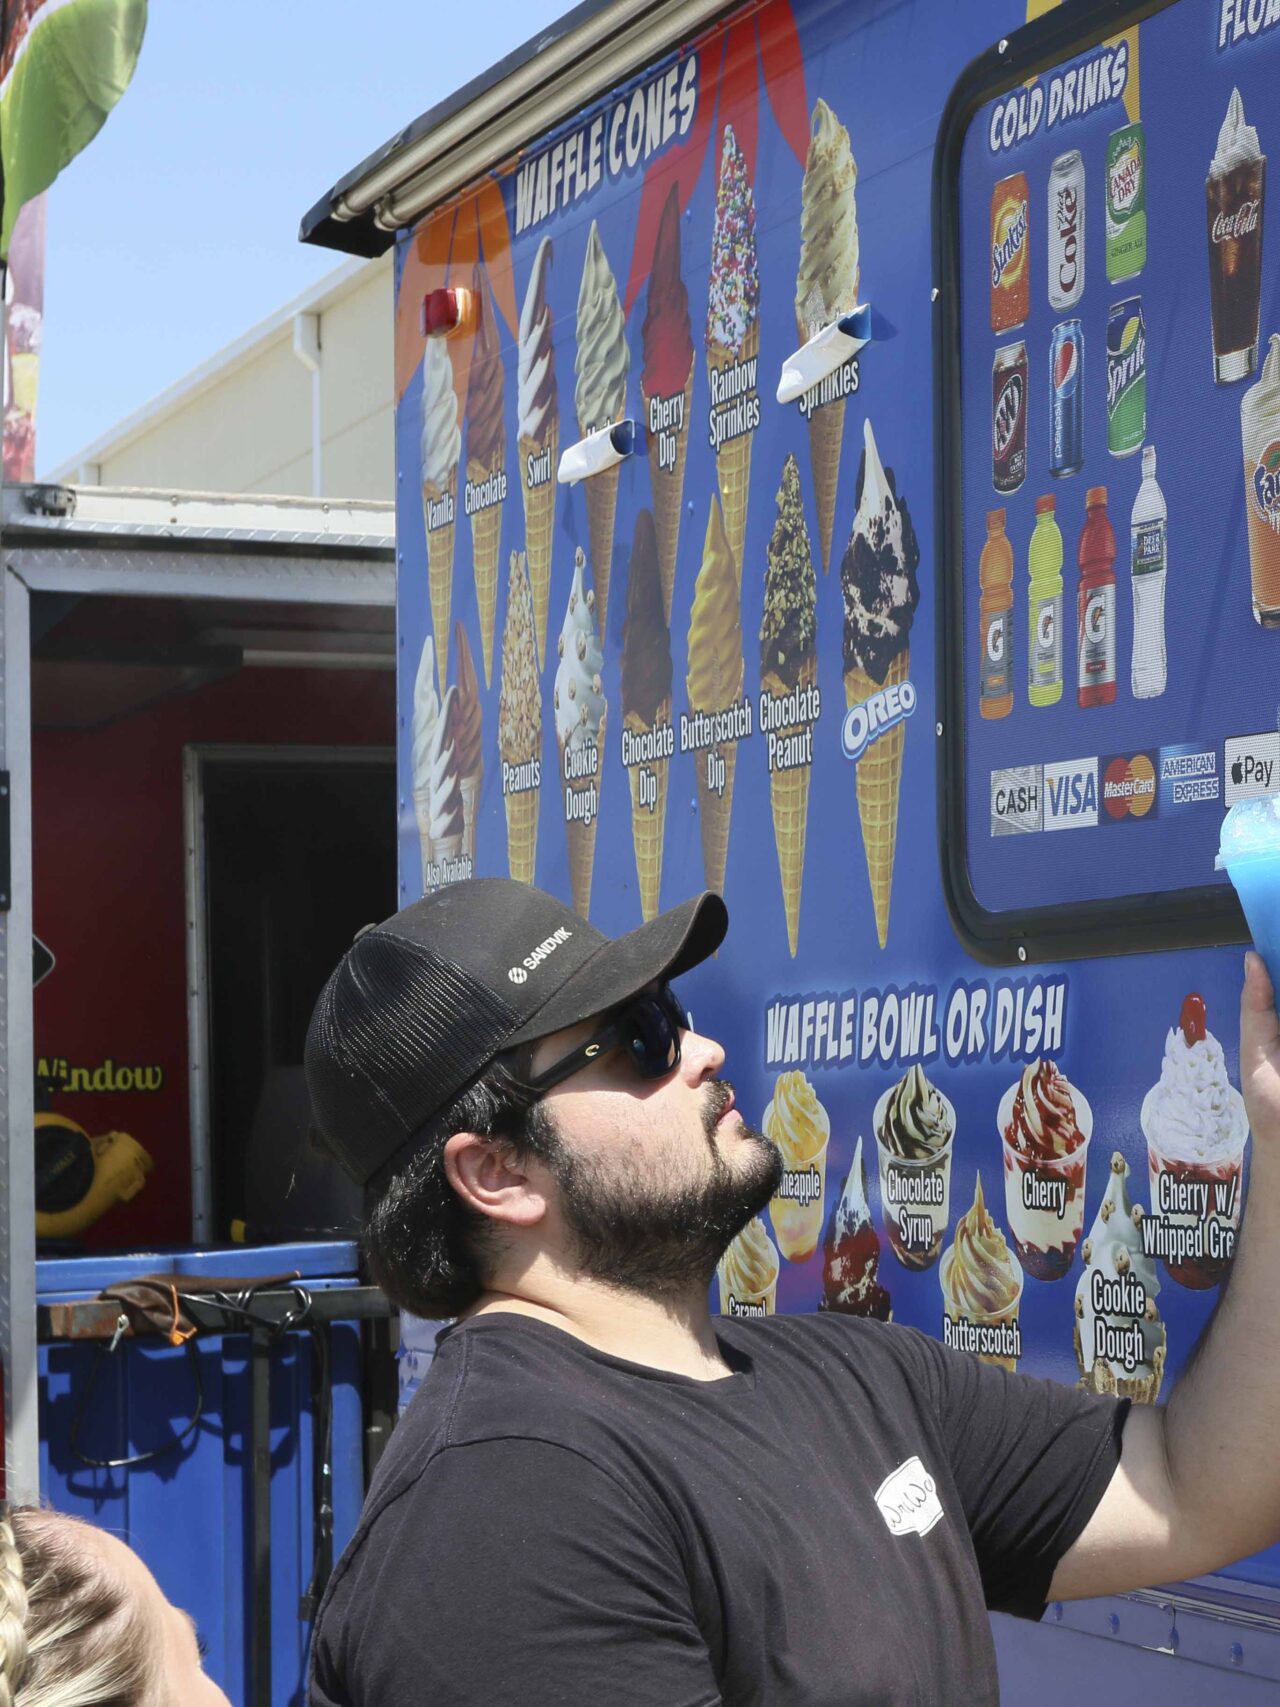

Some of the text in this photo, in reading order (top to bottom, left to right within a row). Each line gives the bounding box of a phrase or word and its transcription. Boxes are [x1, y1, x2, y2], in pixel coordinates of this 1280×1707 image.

[990, 46, 1128, 151] COLD DRINKS
[515, 56, 697, 235] WAFFLE CONES
[1110, 158, 1142, 198] CANADA
[1118, 181, 1137, 202] DRY
[991, 200, 1027, 288] Sunkist
[1059, 187, 1077, 292] Coke
[711, 359, 757, 406] Rainbow
[1107, 330, 1145, 406] Sprite
[650, 393, 684, 433] Cherry
[709, 398, 760, 451] Sprinkles
[527, 447, 551, 487] Swirl
[658, 434, 677, 470] Dip
[426, 492, 454, 531] Vanilla
[464, 472, 507, 515] Chocolate
[1143, 544, 1161, 556] PARK
[680, 698, 752, 751] Butterscotch
[760, 684, 820, 732] Chocolate
[843, 683, 915, 751] OREO
[564, 740, 597, 779] Cookie
[621, 725, 674, 766] Chocolate
[768, 730, 812, 770] Peanut
[1161, 752, 1216, 779] AMERICAN
[503, 758, 541, 793] Peanuts
[639, 771, 657, 811] Dip
[707, 753, 725, 796] Dip
[1173, 779, 1219, 803] EXPRESS
[1244, 755, 1273, 787] Pay
[566, 784, 597, 826] Dough
[995, 773, 1155, 817] CASH VISA MasterCard
[426, 855, 472, 887] Also Available
[522, 926, 573, 970] SANDVIK
[766, 984, 1065, 1064] WAFFLE BOWL OR DISH
[780, 1166, 820, 1204] neapple
[887, 1168, 943, 1202] Chocolate
[1023, 1170, 1065, 1216] Cherry
[1160, 1173, 1237, 1221] Cherry w/
[900, 1210, 932, 1248] Syrup
[1142, 1218, 1235, 1265] Whipped Cre
[1092, 1273, 1145, 1314] Cookie
[943, 1316, 1021, 1355] Butterscotch
[1096, 1320, 1144, 1369] Dough
